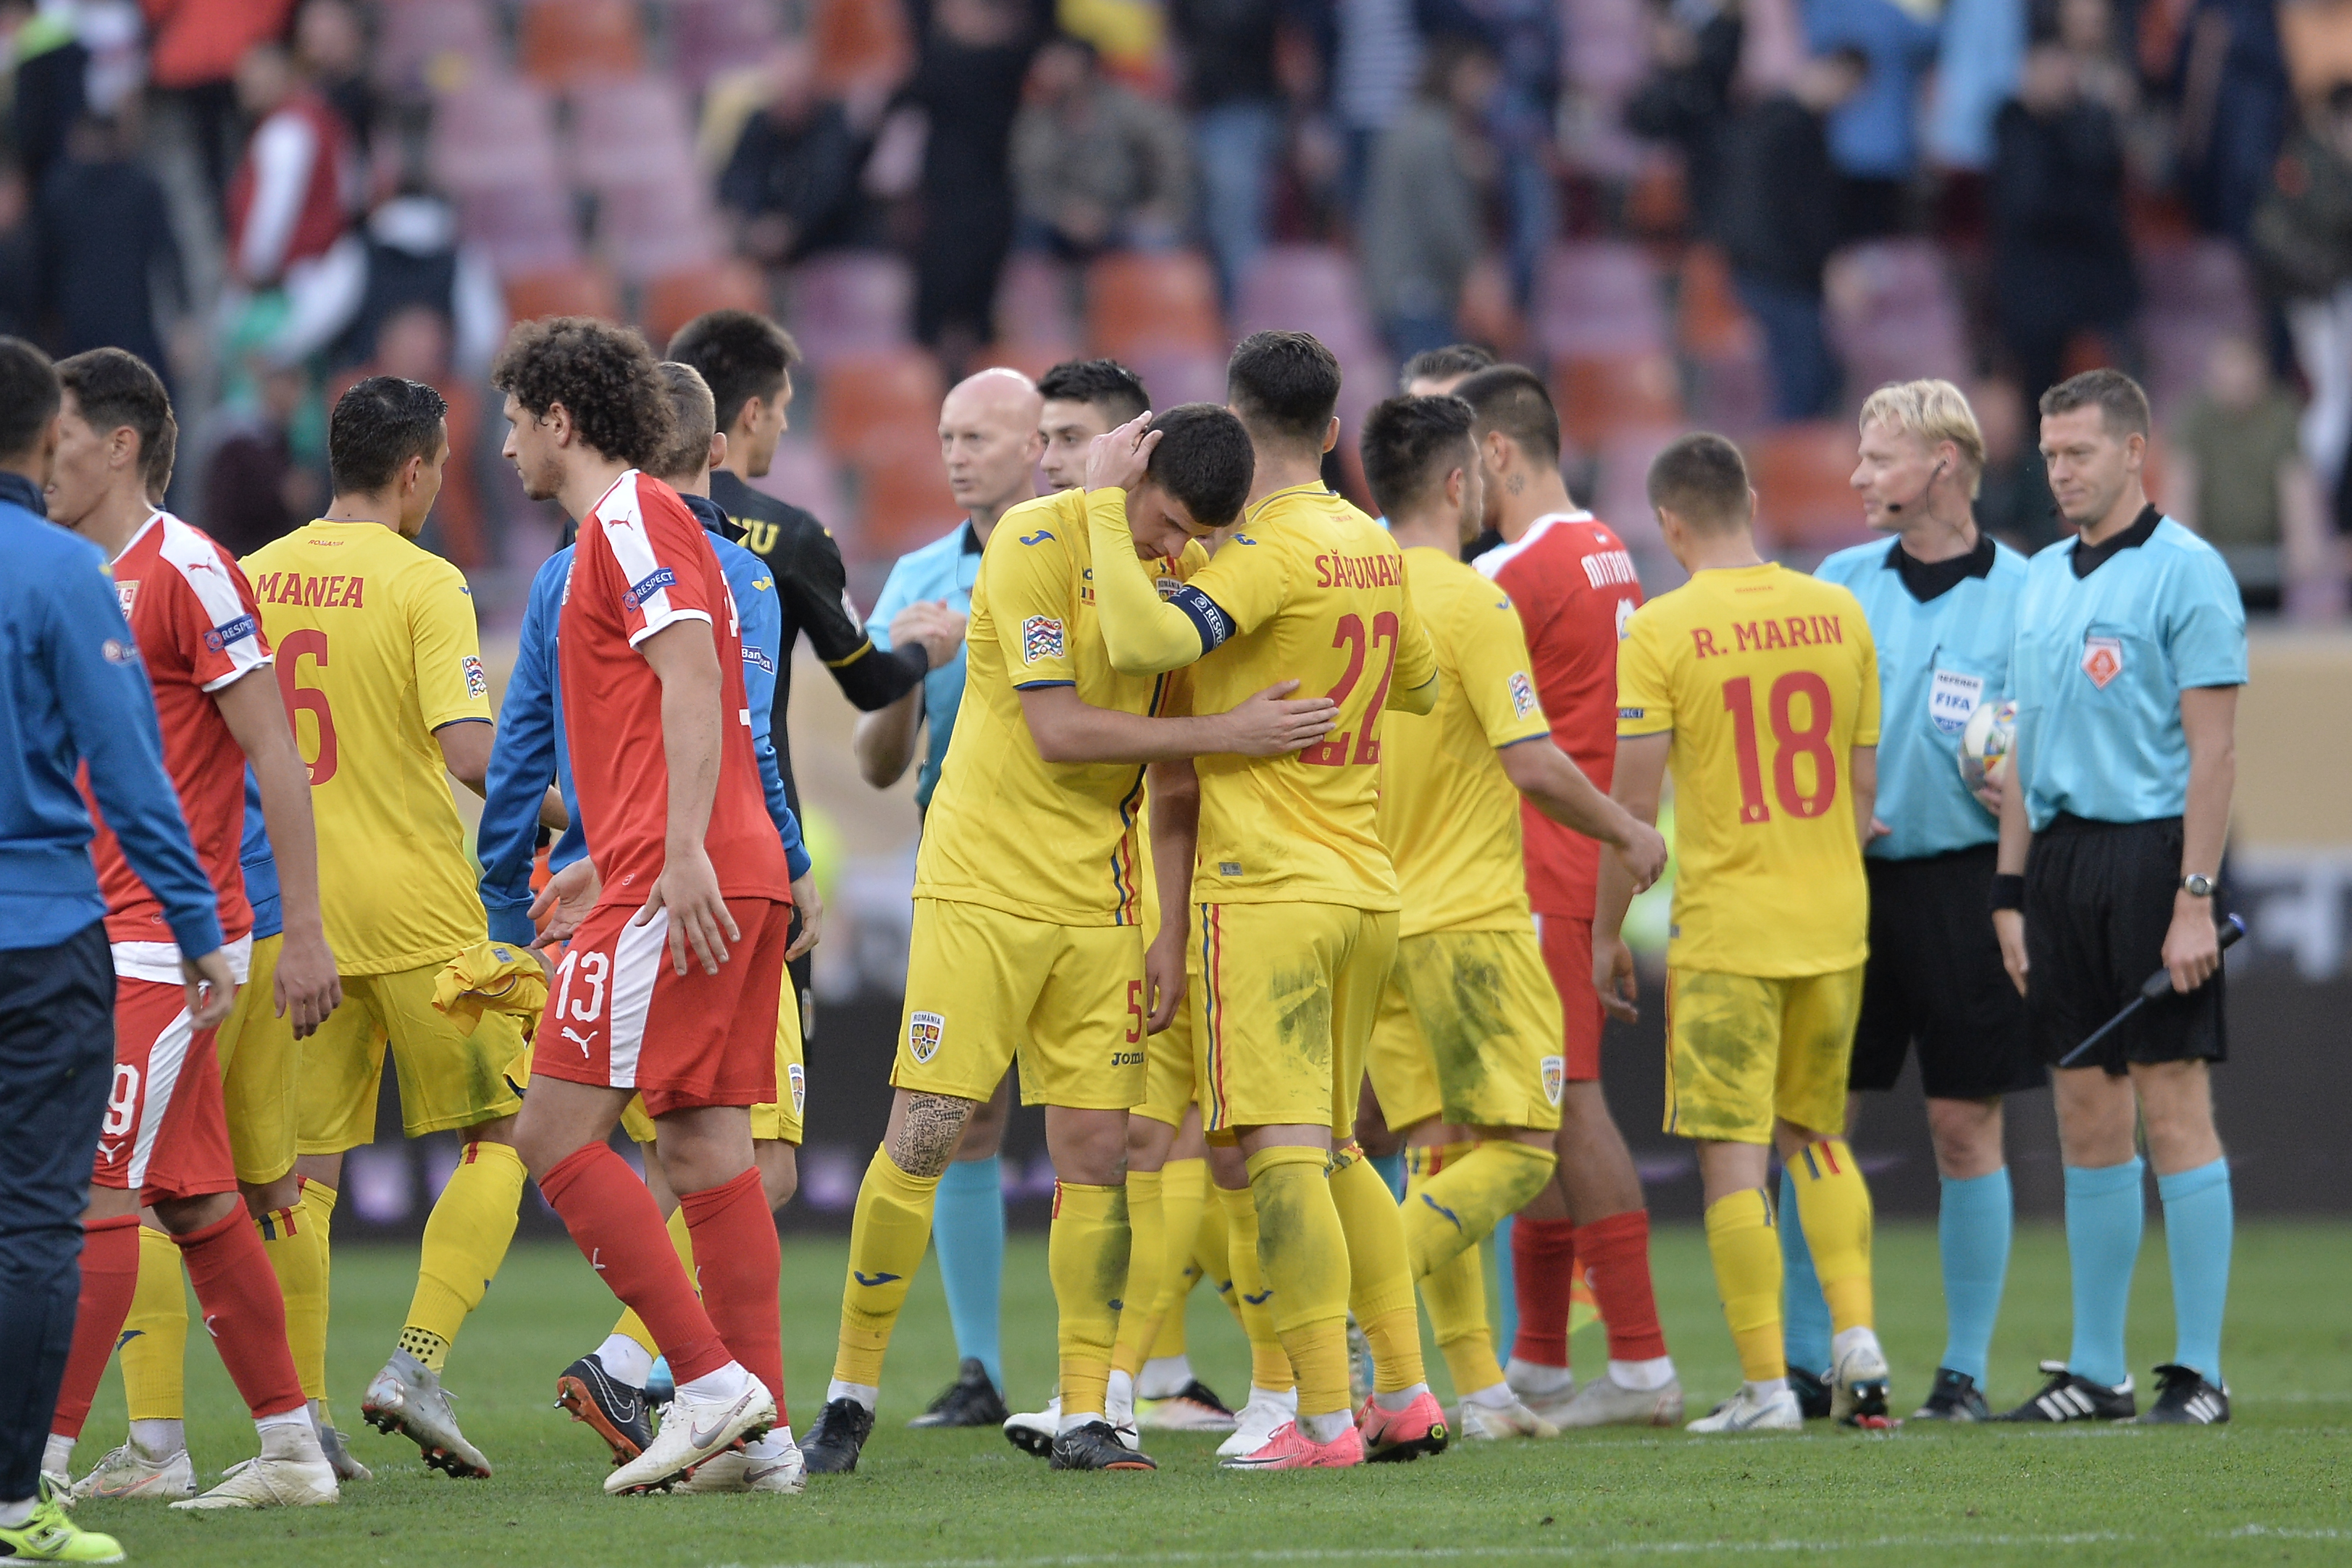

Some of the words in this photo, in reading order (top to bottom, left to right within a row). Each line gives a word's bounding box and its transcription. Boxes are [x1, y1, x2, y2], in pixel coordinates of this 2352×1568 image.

[254, 572, 364, 608] MANEA
[636, 572, 673, 598] RESPECT
[1691, 628, 1728, 658] R.
[1732, 615, 1842, 651] MARIN
[275, 629, 338, 786] 6
[1298, 611, 1399, 766] 22
[1935, 693, 1970, 710] FIFA
[1722, 671, 1837, 823] 18
[556, 950, 609, 1023] 13
[1126, 980, 1142, 1043] 5
[102, 1063, 140, 1136] 9
